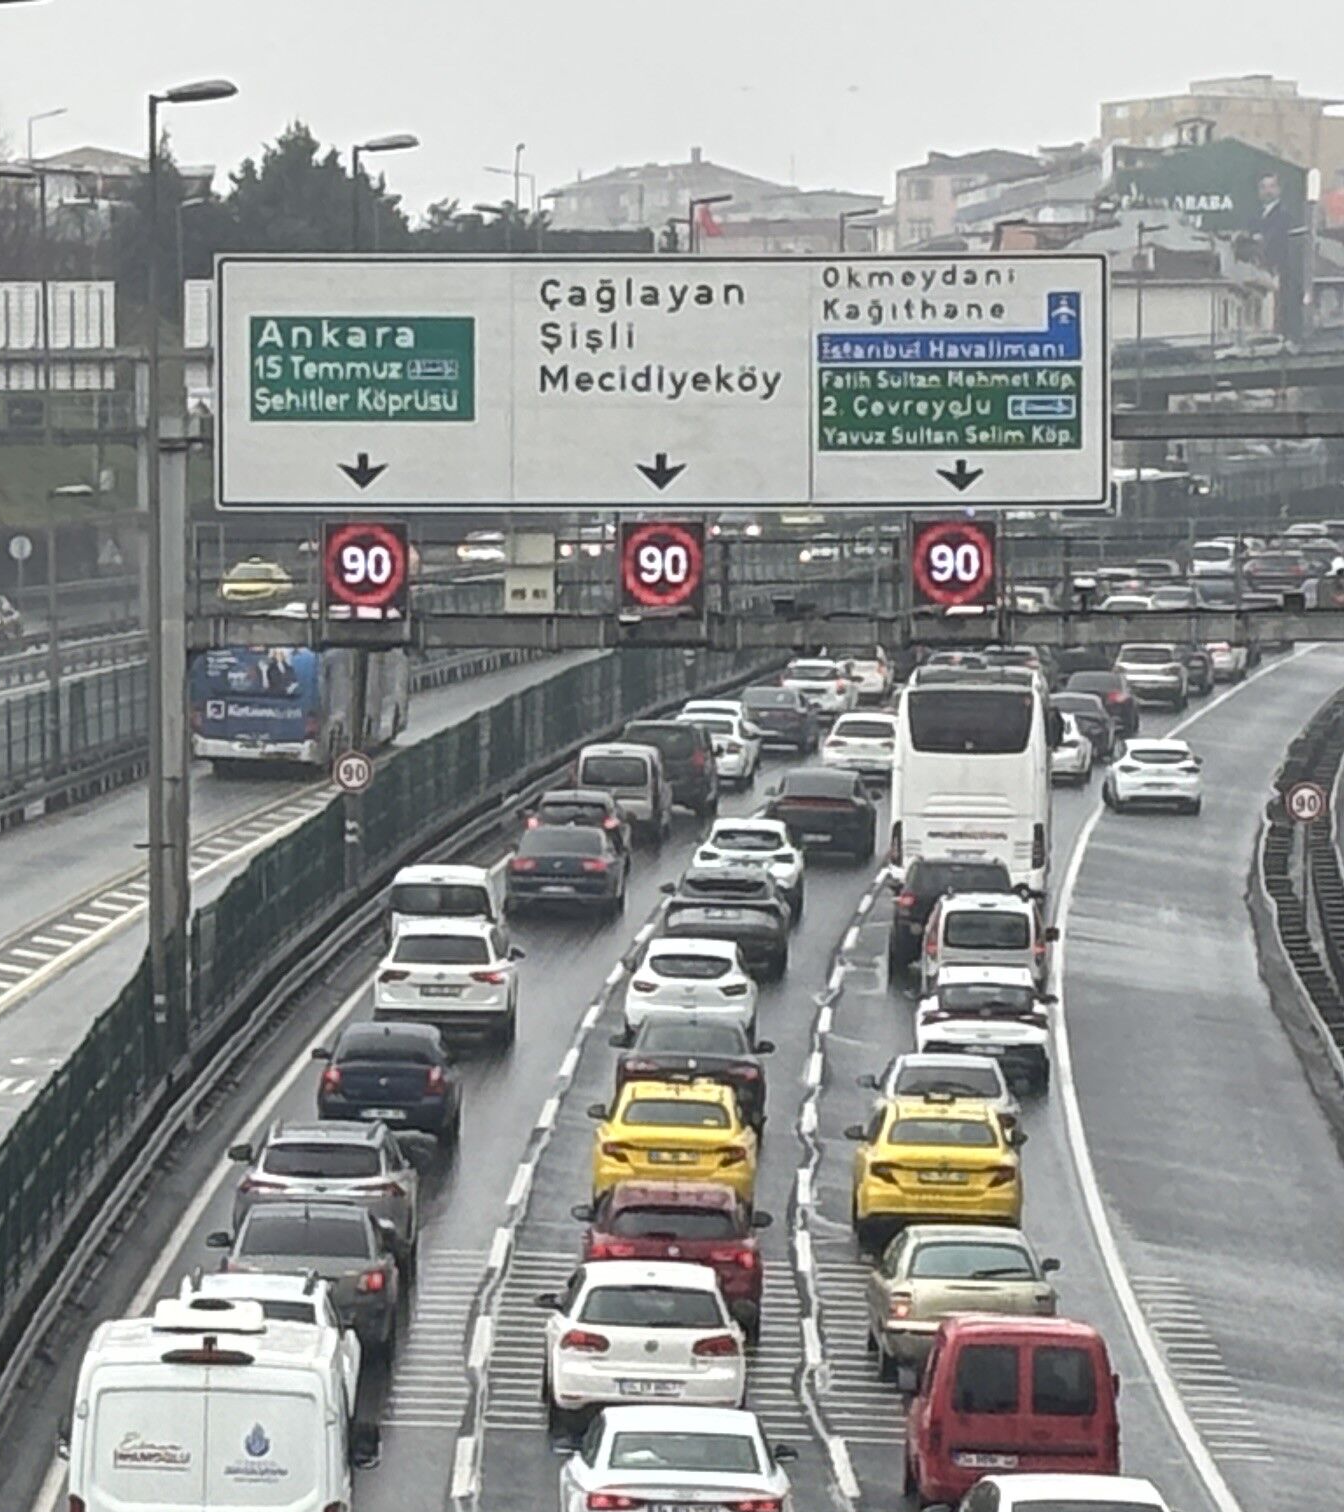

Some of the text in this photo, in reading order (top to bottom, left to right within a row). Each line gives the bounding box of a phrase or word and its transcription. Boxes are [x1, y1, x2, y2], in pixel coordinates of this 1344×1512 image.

[539, 277, 745, 314] Çağlayan
[823, 299, 1006, 325] Kağıthane
[257, 319, 415, 349] Ankara
[540, 321, 634, 354] Şişli
[255, 355, 403, 380] 15 Temmuz
[539, 364, 782, 400] Mecidiyeköy
[822, 370, 871, 389] Fatih
[877, 369, 941, 389] Sultan
[947, 370, 1029, 389] Mehmet
[255, 386, 458, 417] Şehitler Köprüsü
[853, 394, 991, 421] Çevreyolu
[823, 426, 885, 445] Yavuz
[892, 425, 958, 445] Sultan
[965, 425, 1025, 444] Selim
[341, 545, 391, 585] 90
[638, 545, 687, 584] 90
[930, 544, 980, 583] 90
[342, 764, 366, 782] 90
[1296, 794, 1317, 813] 90
